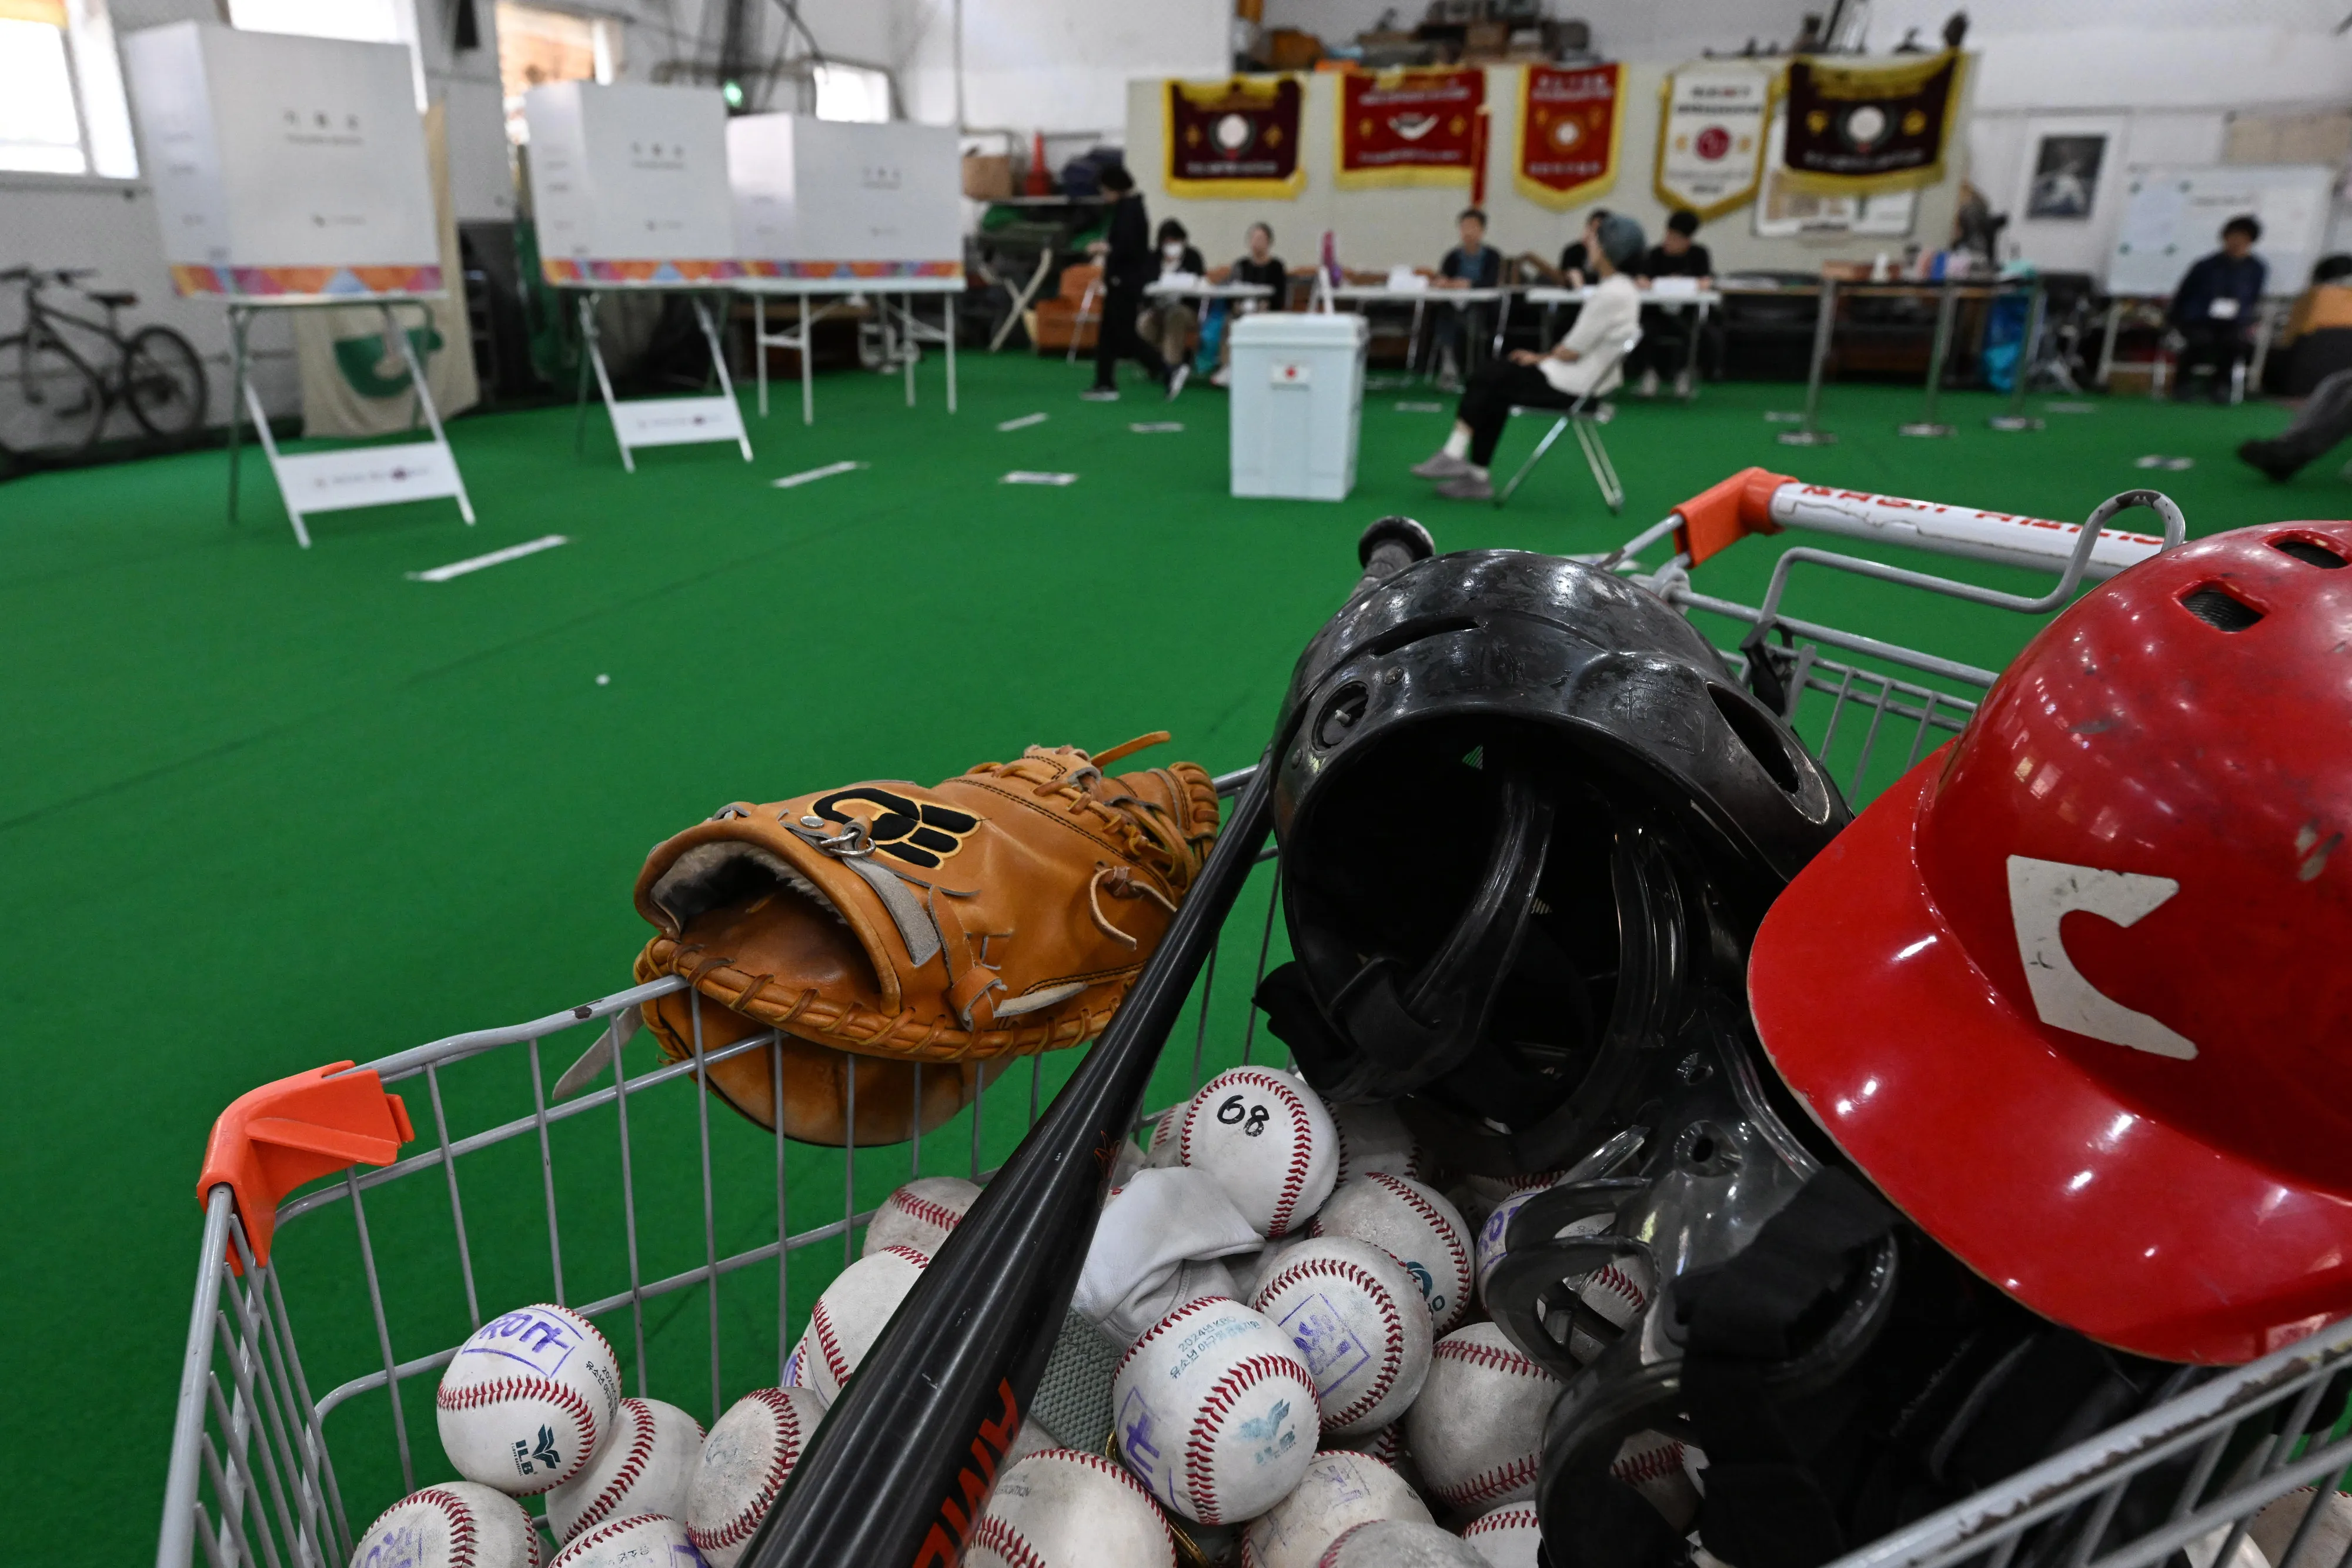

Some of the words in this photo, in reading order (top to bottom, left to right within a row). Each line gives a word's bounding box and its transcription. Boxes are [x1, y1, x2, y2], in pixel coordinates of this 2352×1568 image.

[1217, 1095, 1270, 1138] 68
[586, 1360, 605, 1386] 유소년
[516, 1439, 534, 1475] ILB
